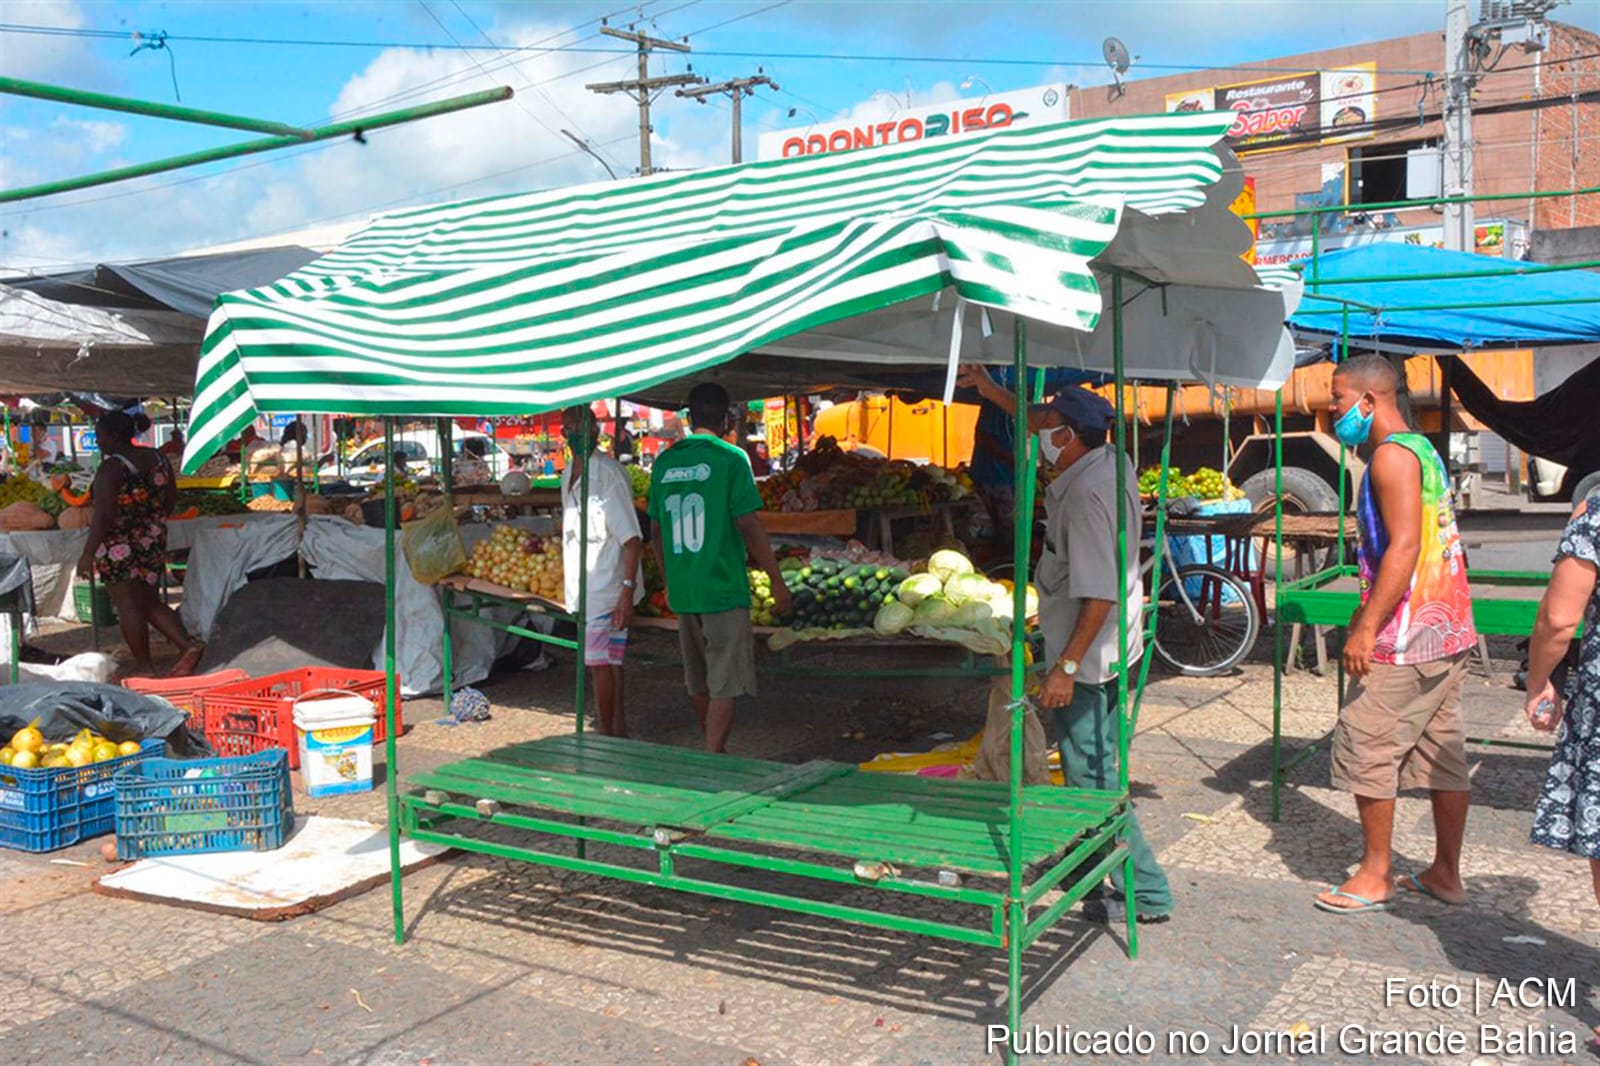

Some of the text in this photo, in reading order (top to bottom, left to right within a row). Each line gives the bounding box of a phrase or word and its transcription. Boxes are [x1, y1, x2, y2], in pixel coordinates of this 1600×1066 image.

[1226, 81, 1306, 101] Restaurante
[782, 103, 1016, 158] ODONTORISO
[1227, 100, 1307, 137] Sabor
[664, 492, 705, 554] 10
